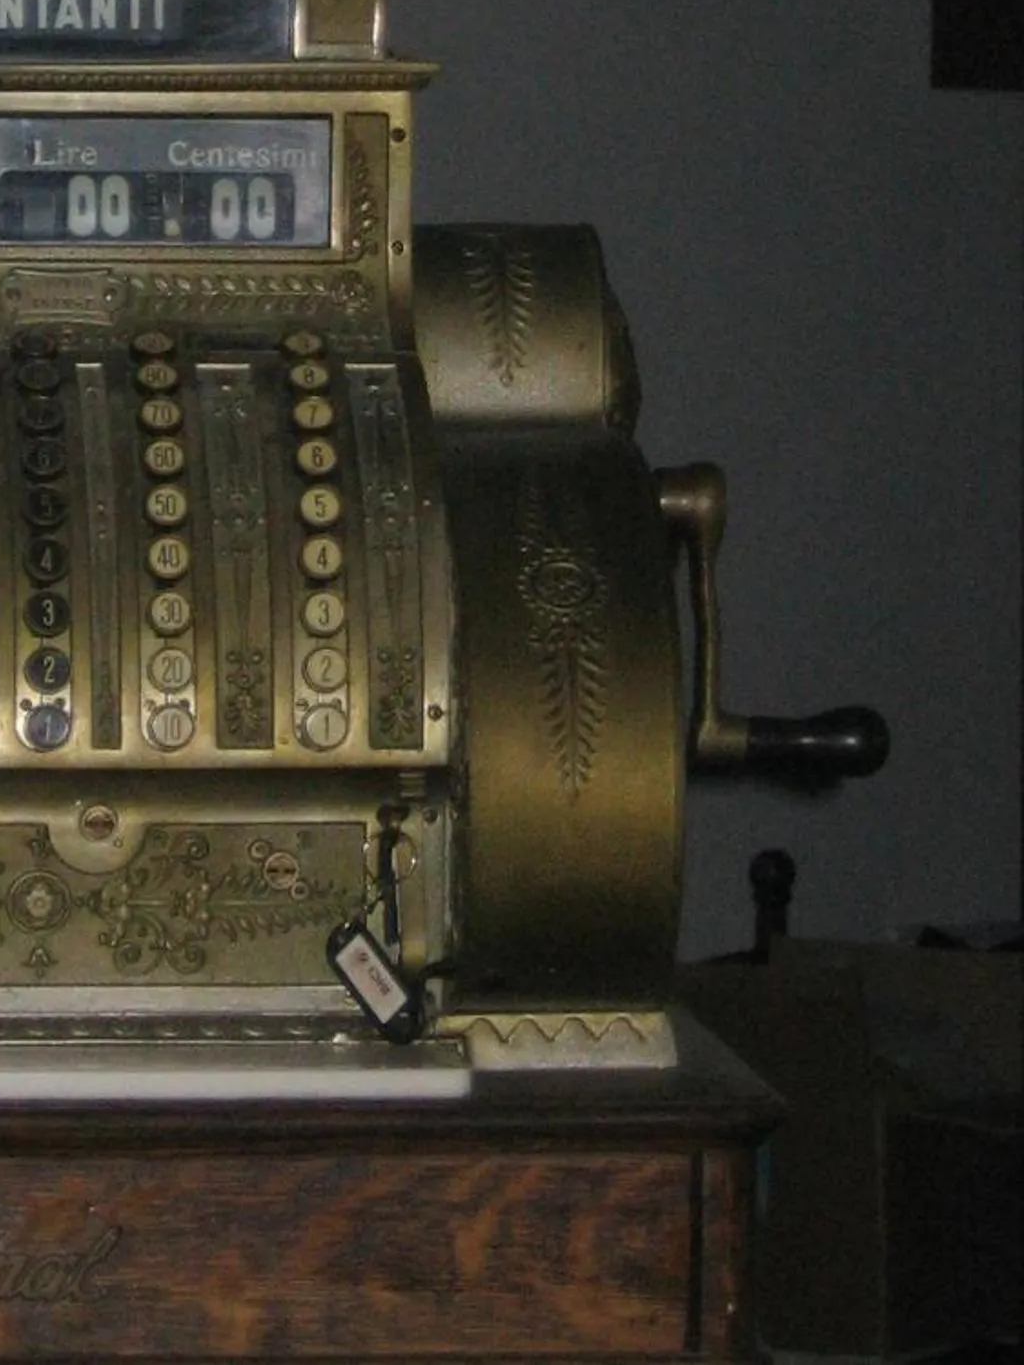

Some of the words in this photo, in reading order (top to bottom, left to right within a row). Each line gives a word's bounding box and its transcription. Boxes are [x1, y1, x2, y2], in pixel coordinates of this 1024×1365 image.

[32, 140, 97, 166] Lire
[168, 141, 318, 168] Centesimi
[155, 494, 177, 518] 50
[156, 545, 179, 569] 40
[160, 600, 182, 625] 30
[162, 656, 184, 683] 20
[163, 713, 185, 740] 10
